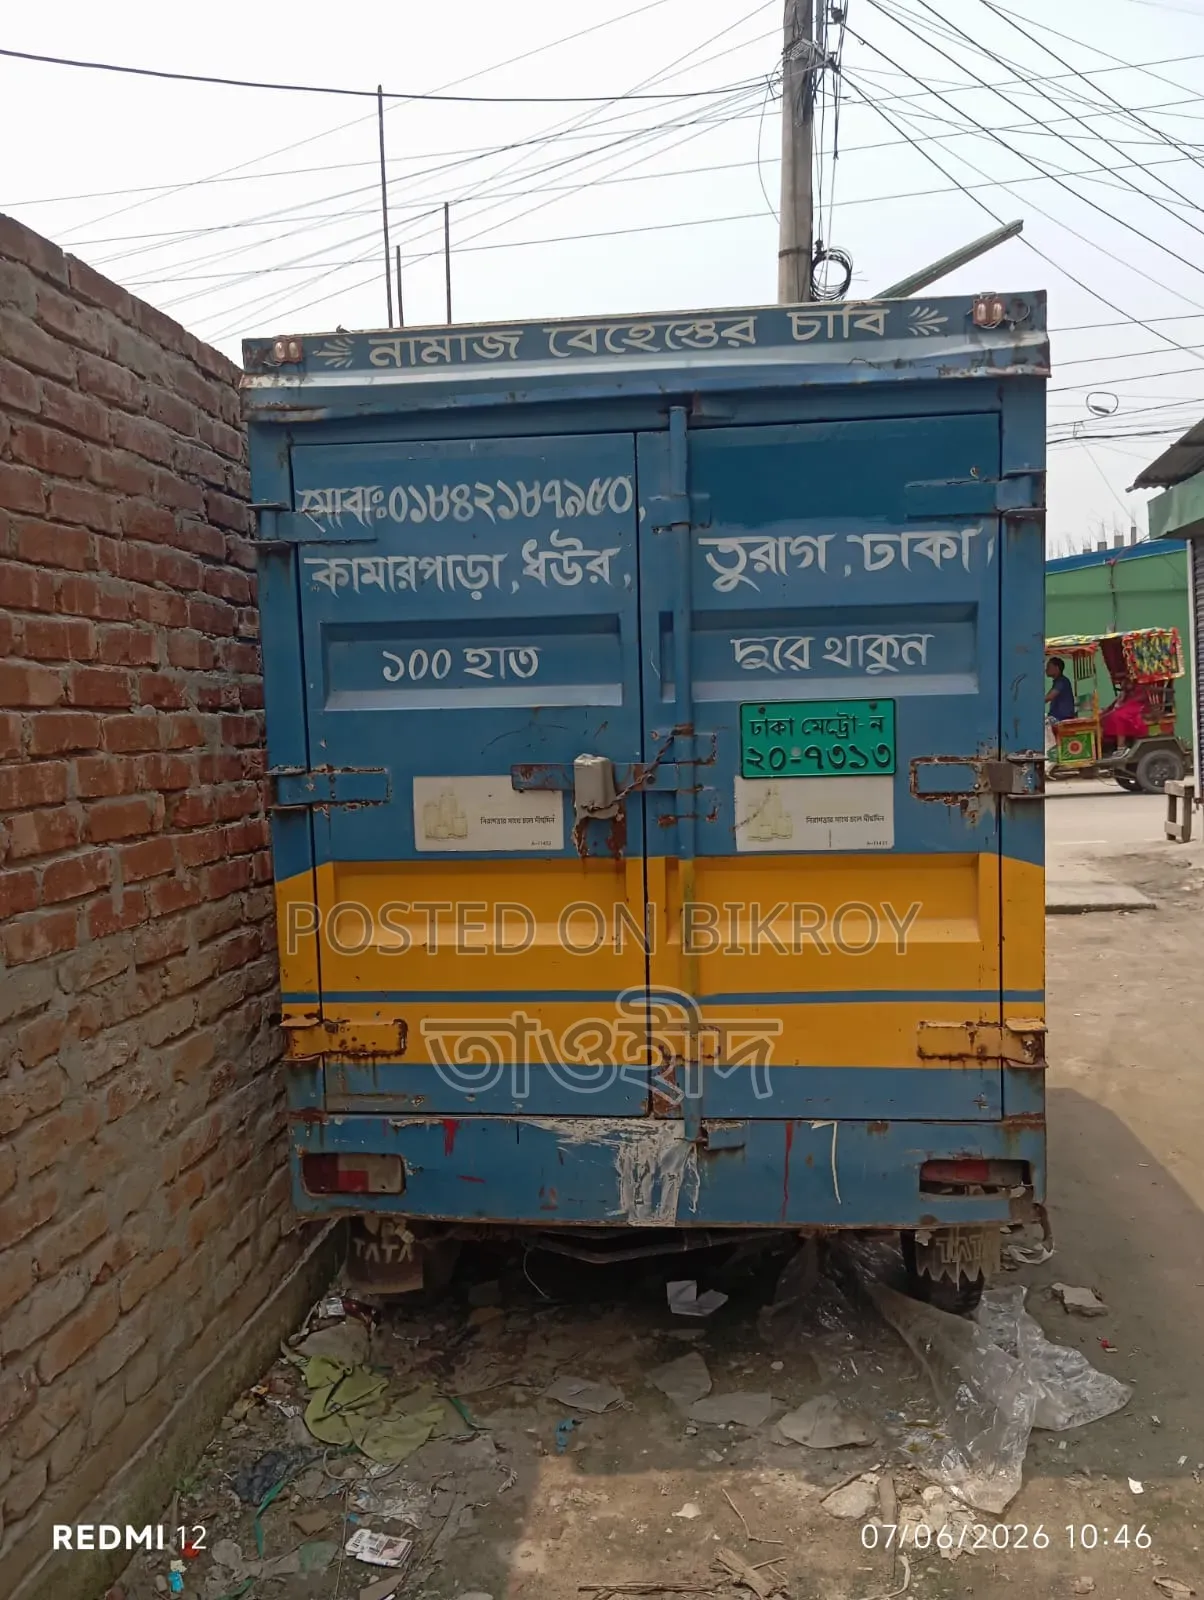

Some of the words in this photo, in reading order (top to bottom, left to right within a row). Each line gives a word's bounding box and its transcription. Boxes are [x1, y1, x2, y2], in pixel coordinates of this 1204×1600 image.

[368, 330, 523, 368] নামাজ
[786, 304, 890, 341] চাবি
[382, 649, 452, 682] ১০০
[463, 646, 542, 679] হাত
[822, 633, 935, 675] থাকুন
[749, 716, 795, 737] ঢাকা
[869, 715, 885, 734] ন
[746, 743, 891, 770] ২০-৭৩১৩
[352, 1238, 413, 1264] TATA
